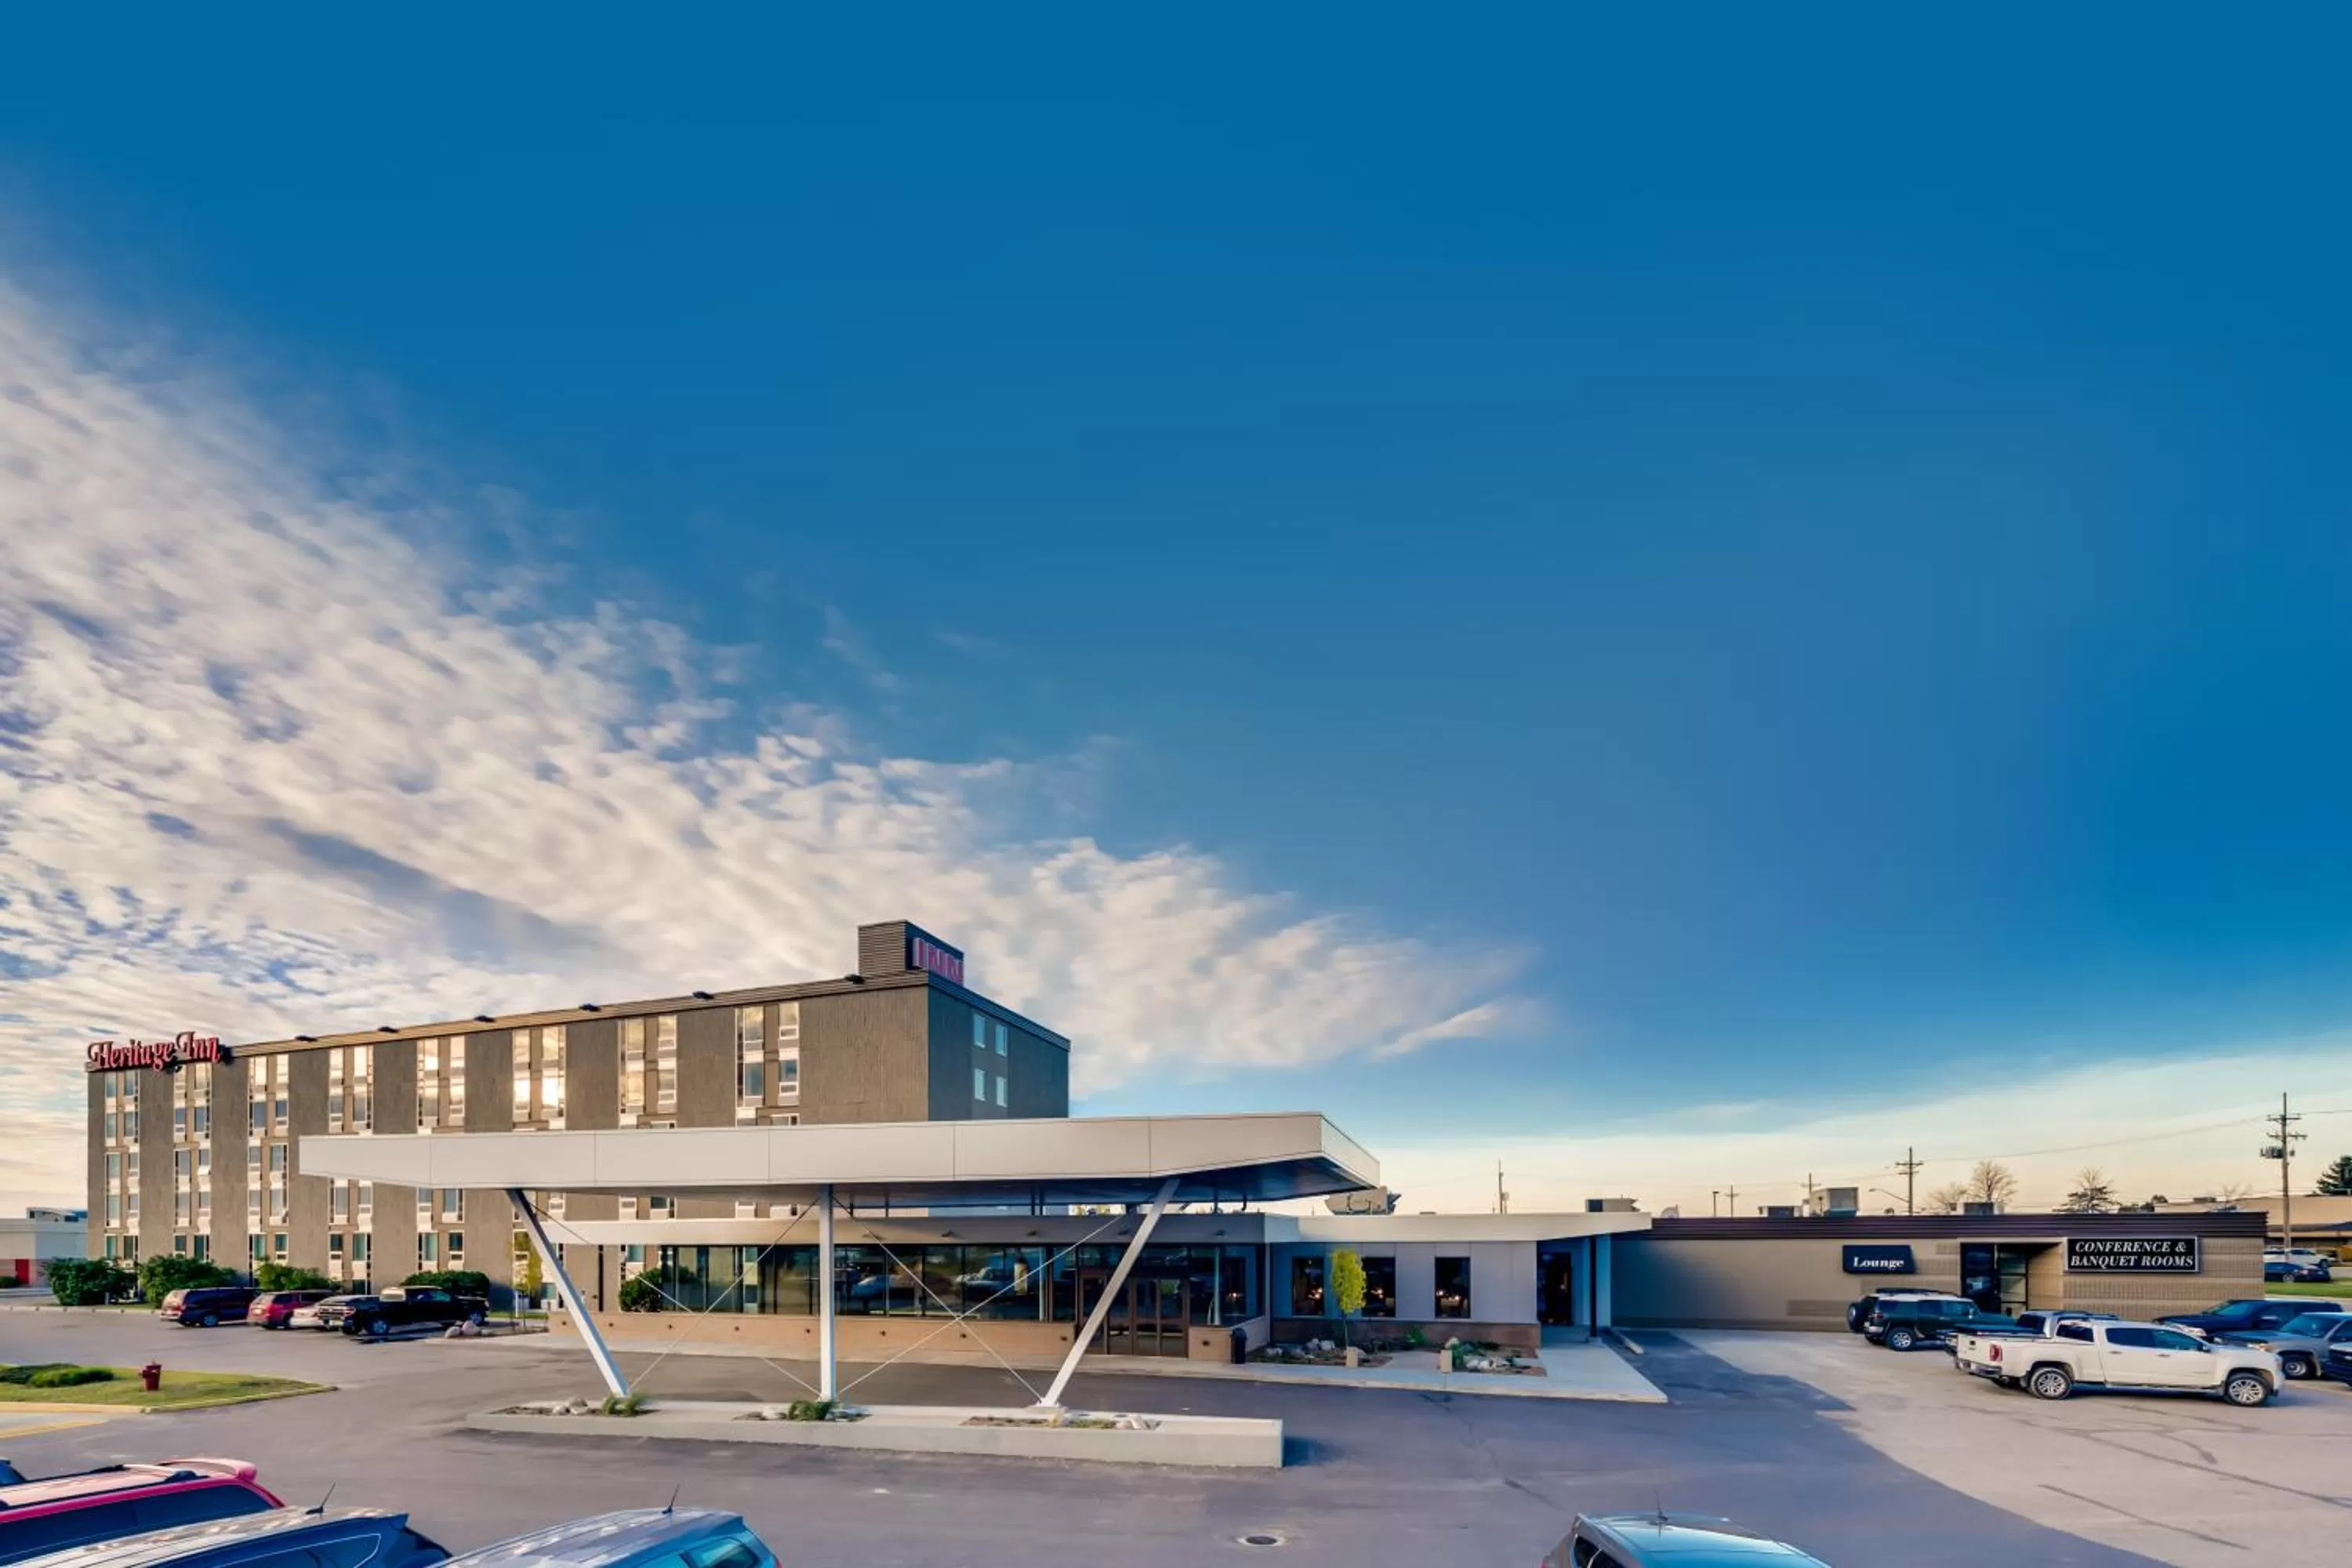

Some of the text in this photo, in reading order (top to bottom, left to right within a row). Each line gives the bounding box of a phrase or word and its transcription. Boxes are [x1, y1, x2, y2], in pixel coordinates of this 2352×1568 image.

[87, 1031, 221, 1073] Heritage Inn
[2075, 1241, 2187, 1252] CONFERENCE &
[1853, 1257, 1904, 1271] Lounge
[2071, 1255, 2194, 1269] BANQUET ROOMS
